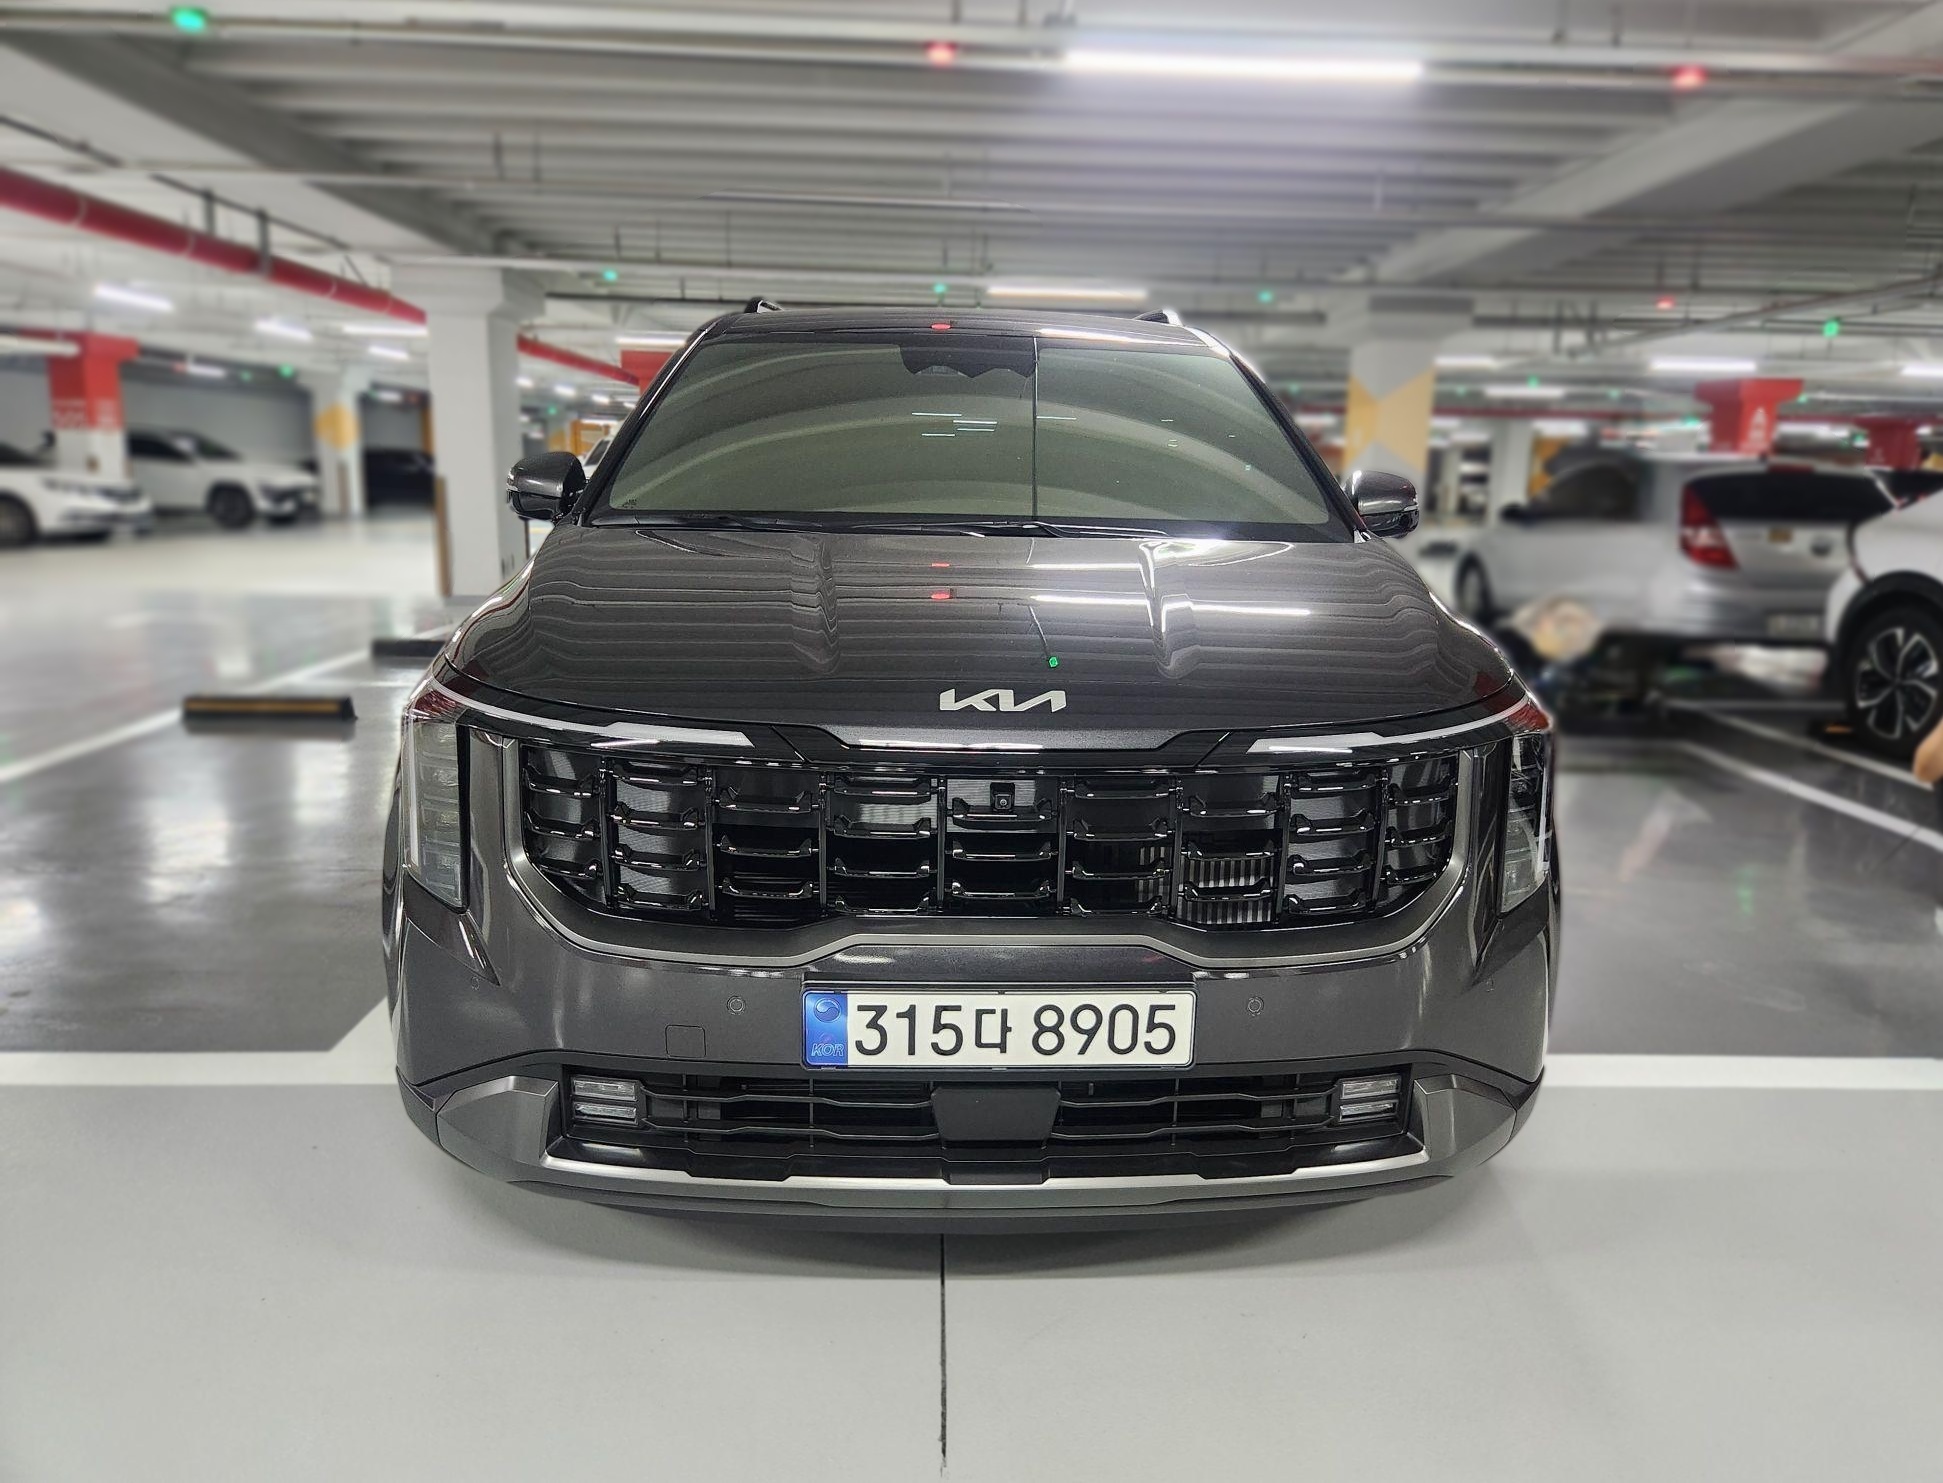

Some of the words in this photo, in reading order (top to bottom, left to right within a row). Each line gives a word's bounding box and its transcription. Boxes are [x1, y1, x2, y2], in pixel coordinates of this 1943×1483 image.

[939, 688, 1067, 713] KIA
[854, 1003, 1013, 1056] 315다
[1031, 1003, 1177, 1056] 8905
[810, 1043, 845, 1057] KOR
